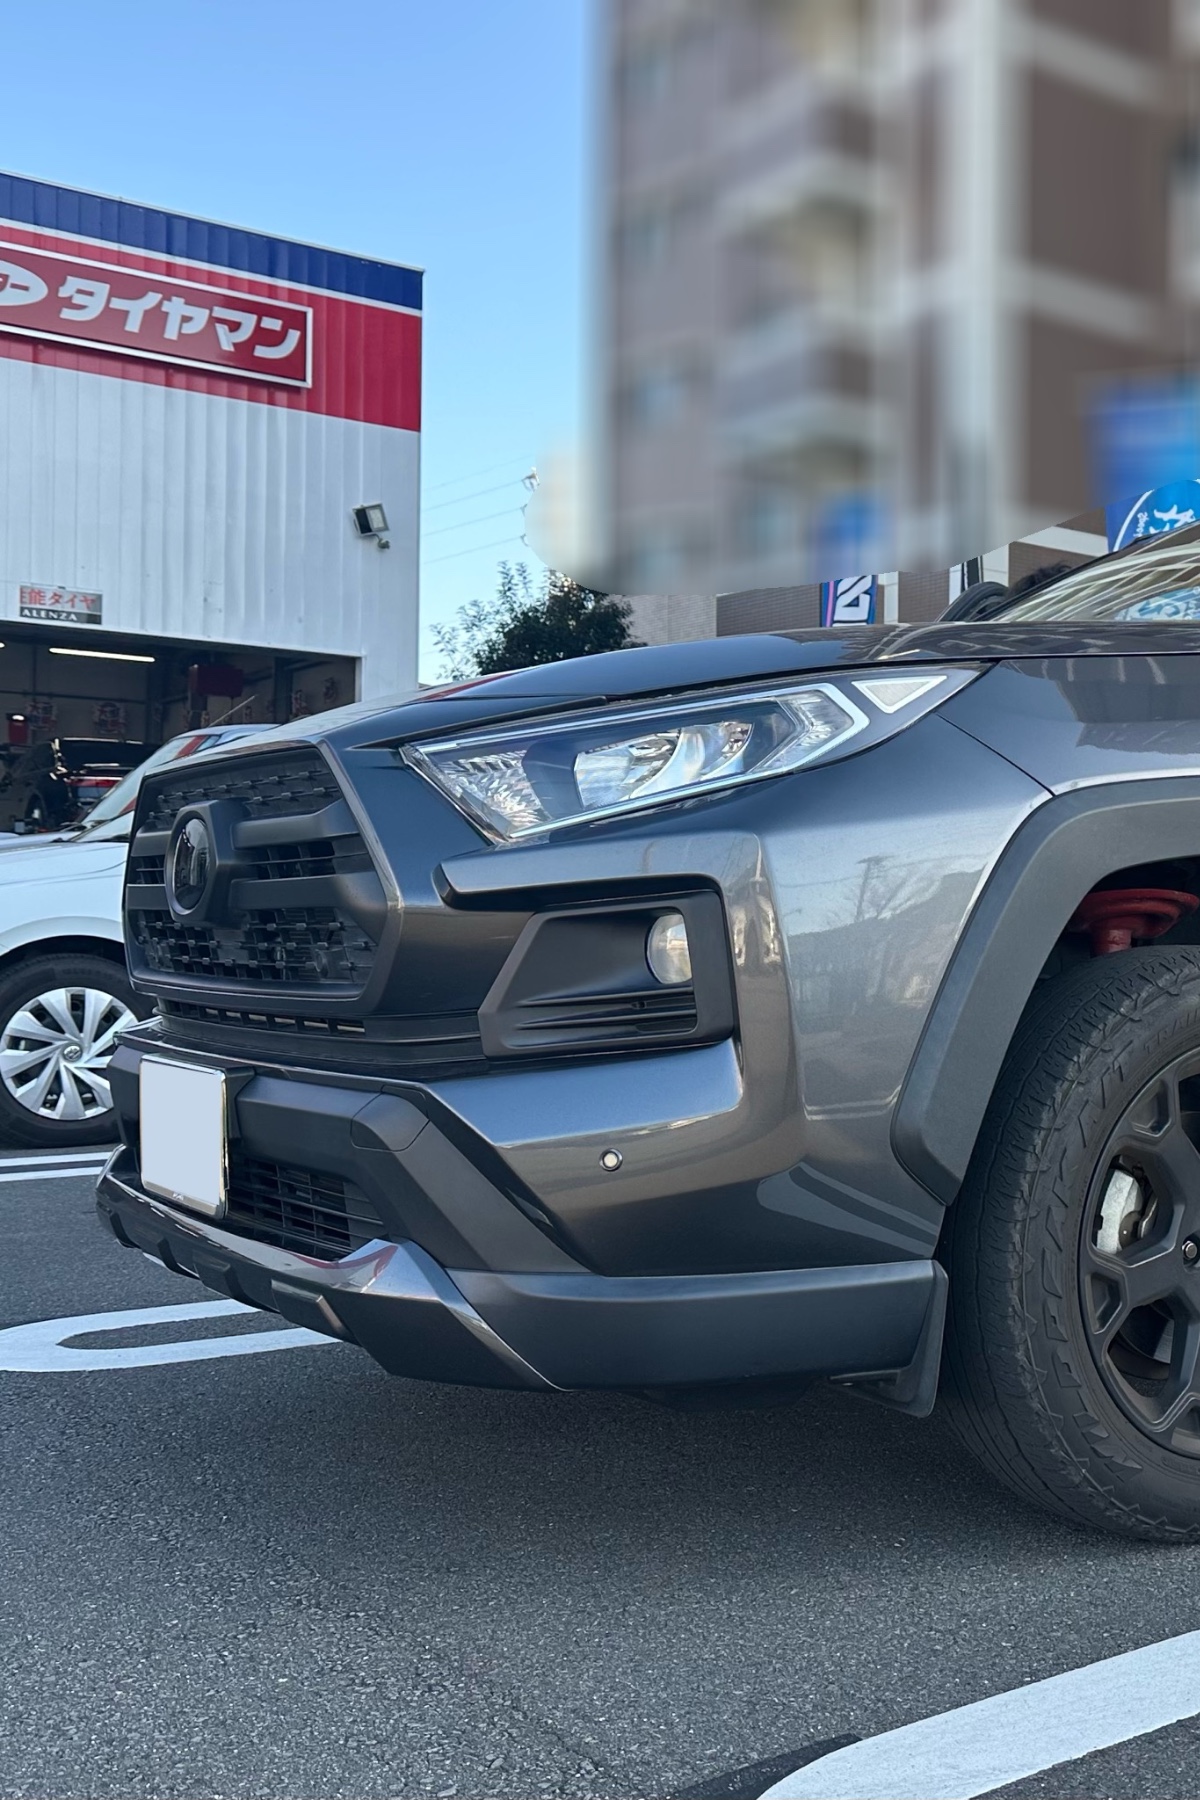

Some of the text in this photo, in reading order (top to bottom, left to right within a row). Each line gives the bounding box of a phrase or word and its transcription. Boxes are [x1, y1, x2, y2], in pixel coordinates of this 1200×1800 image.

[57, 275, 301, 360] タイヤマン
[22, 608, 78, 622] ALENZA
